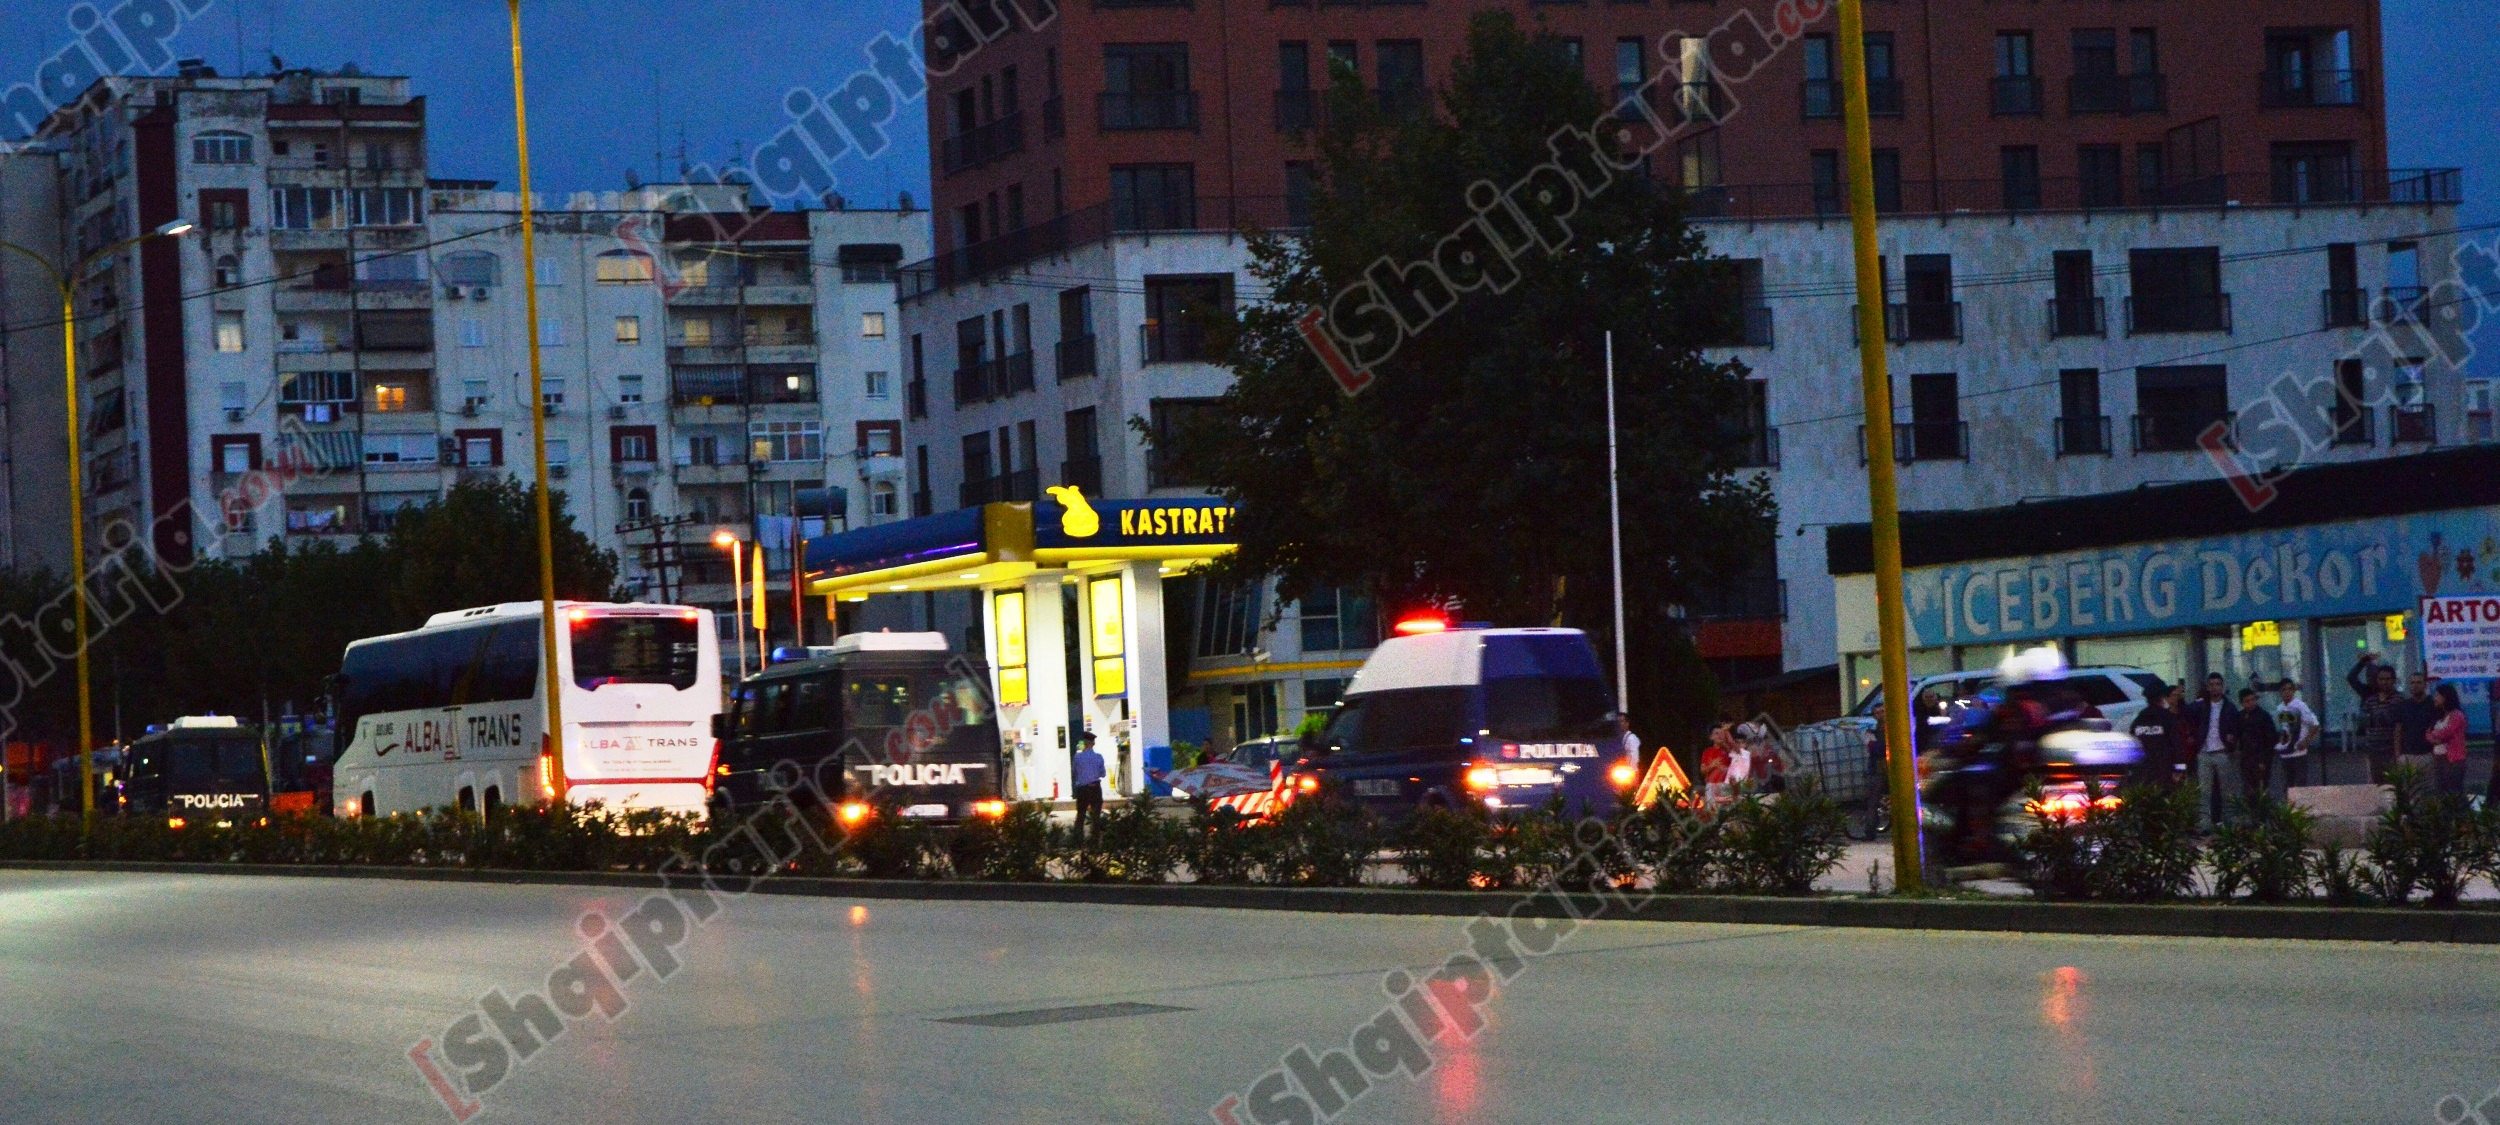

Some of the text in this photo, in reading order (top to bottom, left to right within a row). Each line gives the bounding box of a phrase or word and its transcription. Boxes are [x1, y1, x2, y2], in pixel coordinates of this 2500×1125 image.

[1941, 535, 2389, 639] ICEBERG Dekor
[404, 721, 441, 753] ALBA
[468, 713, 521, 748] TRANS
[647, 738, 698, 747] TRANS
[1519, 743, 1600, 758] POLICIA
[871, 763, 966, 786] POLICIA
[184, 793, 245, 809] POLICIA
